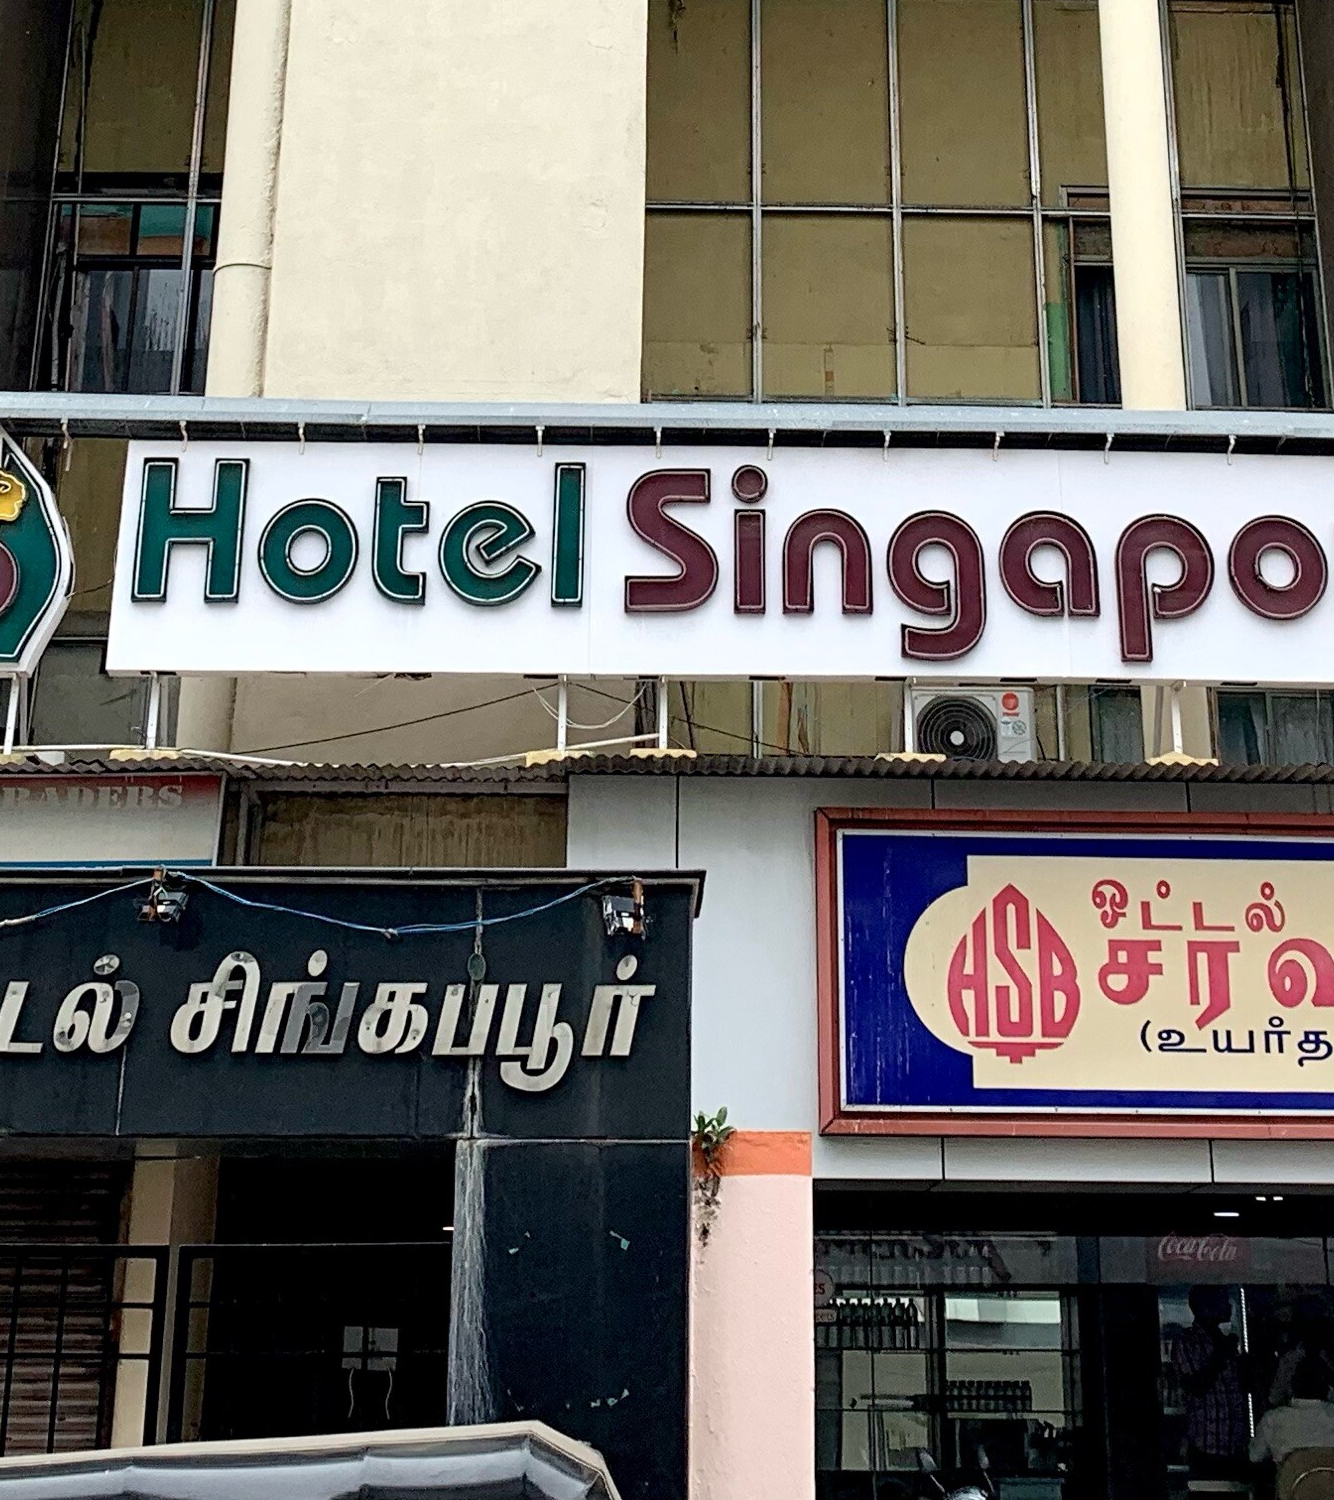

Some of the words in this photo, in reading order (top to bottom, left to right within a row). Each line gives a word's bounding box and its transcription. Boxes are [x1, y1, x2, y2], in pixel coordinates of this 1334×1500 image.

[130, 457, 587, 608] Hotel
[947, 883, 1080, 1038] HSB
[1091, 878, 1286, 934] ஓட்டல்
[170, 949, 657, 1092] சிங்கப்பூர்
